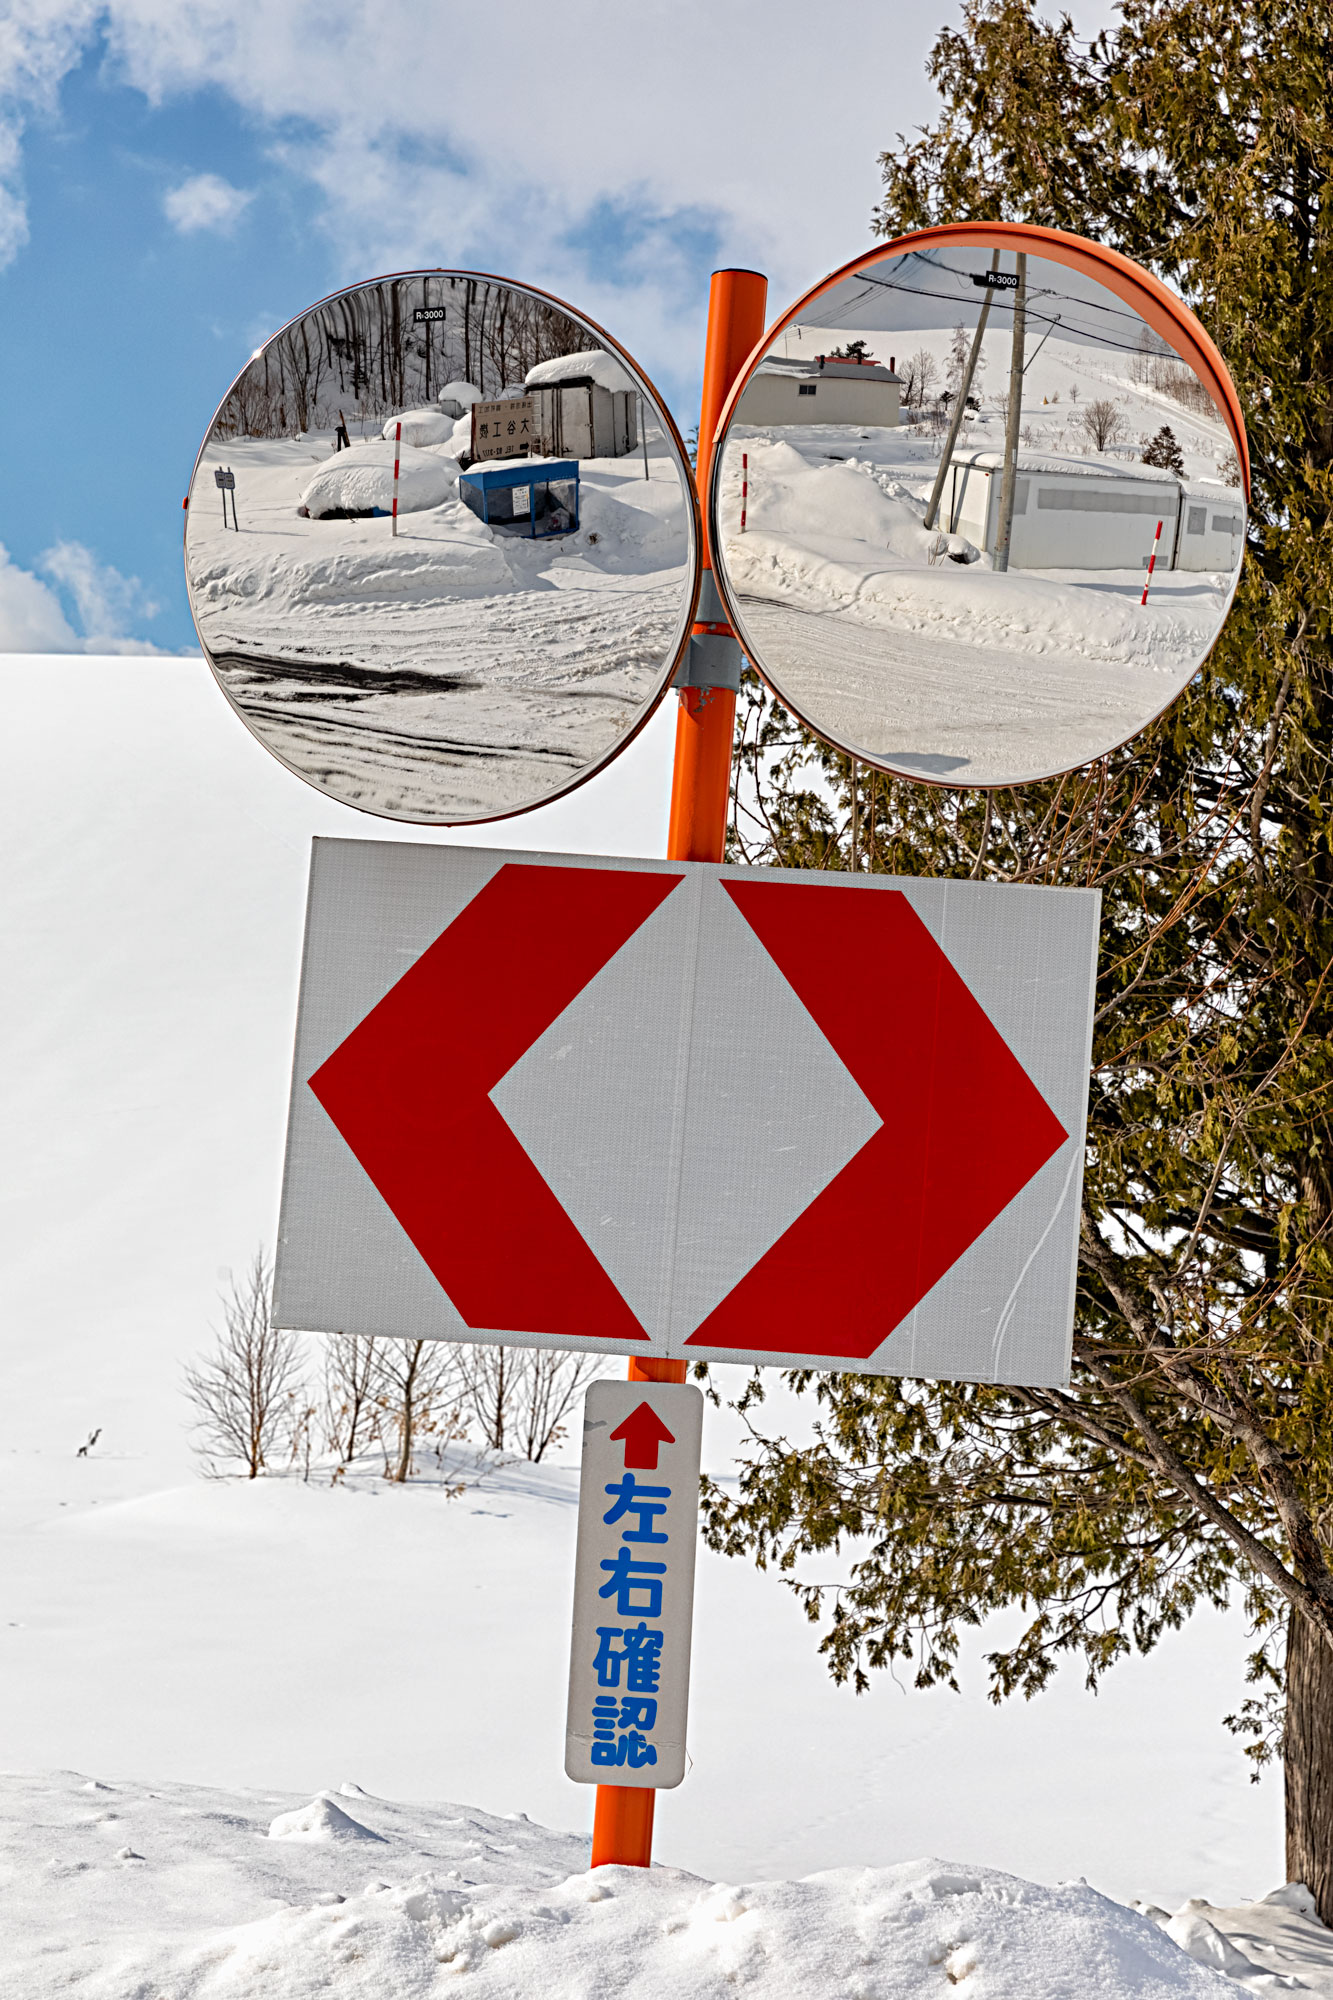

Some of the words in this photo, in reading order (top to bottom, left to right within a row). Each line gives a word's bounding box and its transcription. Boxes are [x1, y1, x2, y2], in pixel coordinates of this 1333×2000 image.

[988, 274, 1018, 286] R=3000
[590, 1472, 672, 1769] 左右確認
